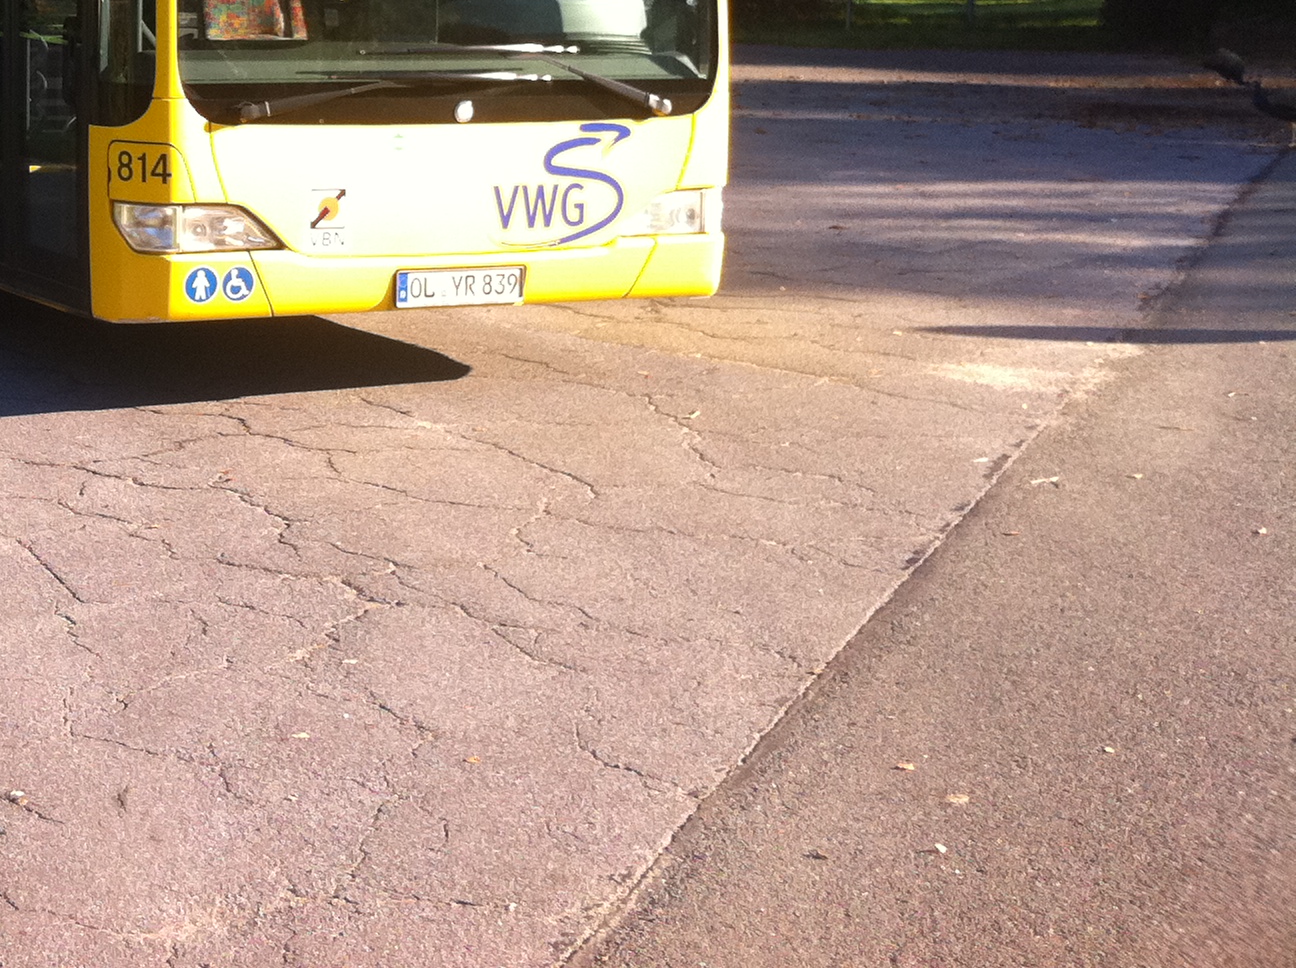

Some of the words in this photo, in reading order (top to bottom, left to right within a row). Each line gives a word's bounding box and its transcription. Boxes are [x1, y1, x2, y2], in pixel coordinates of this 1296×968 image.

[117, 150, 172, 184] 814
[493, 182, 585, 230] VWG
[310, 231, 346, 246] VBN
[409, 277, 435, 299] OL
[452, 274, 476, 297] YR
[482, 272, 518, 296] 839
